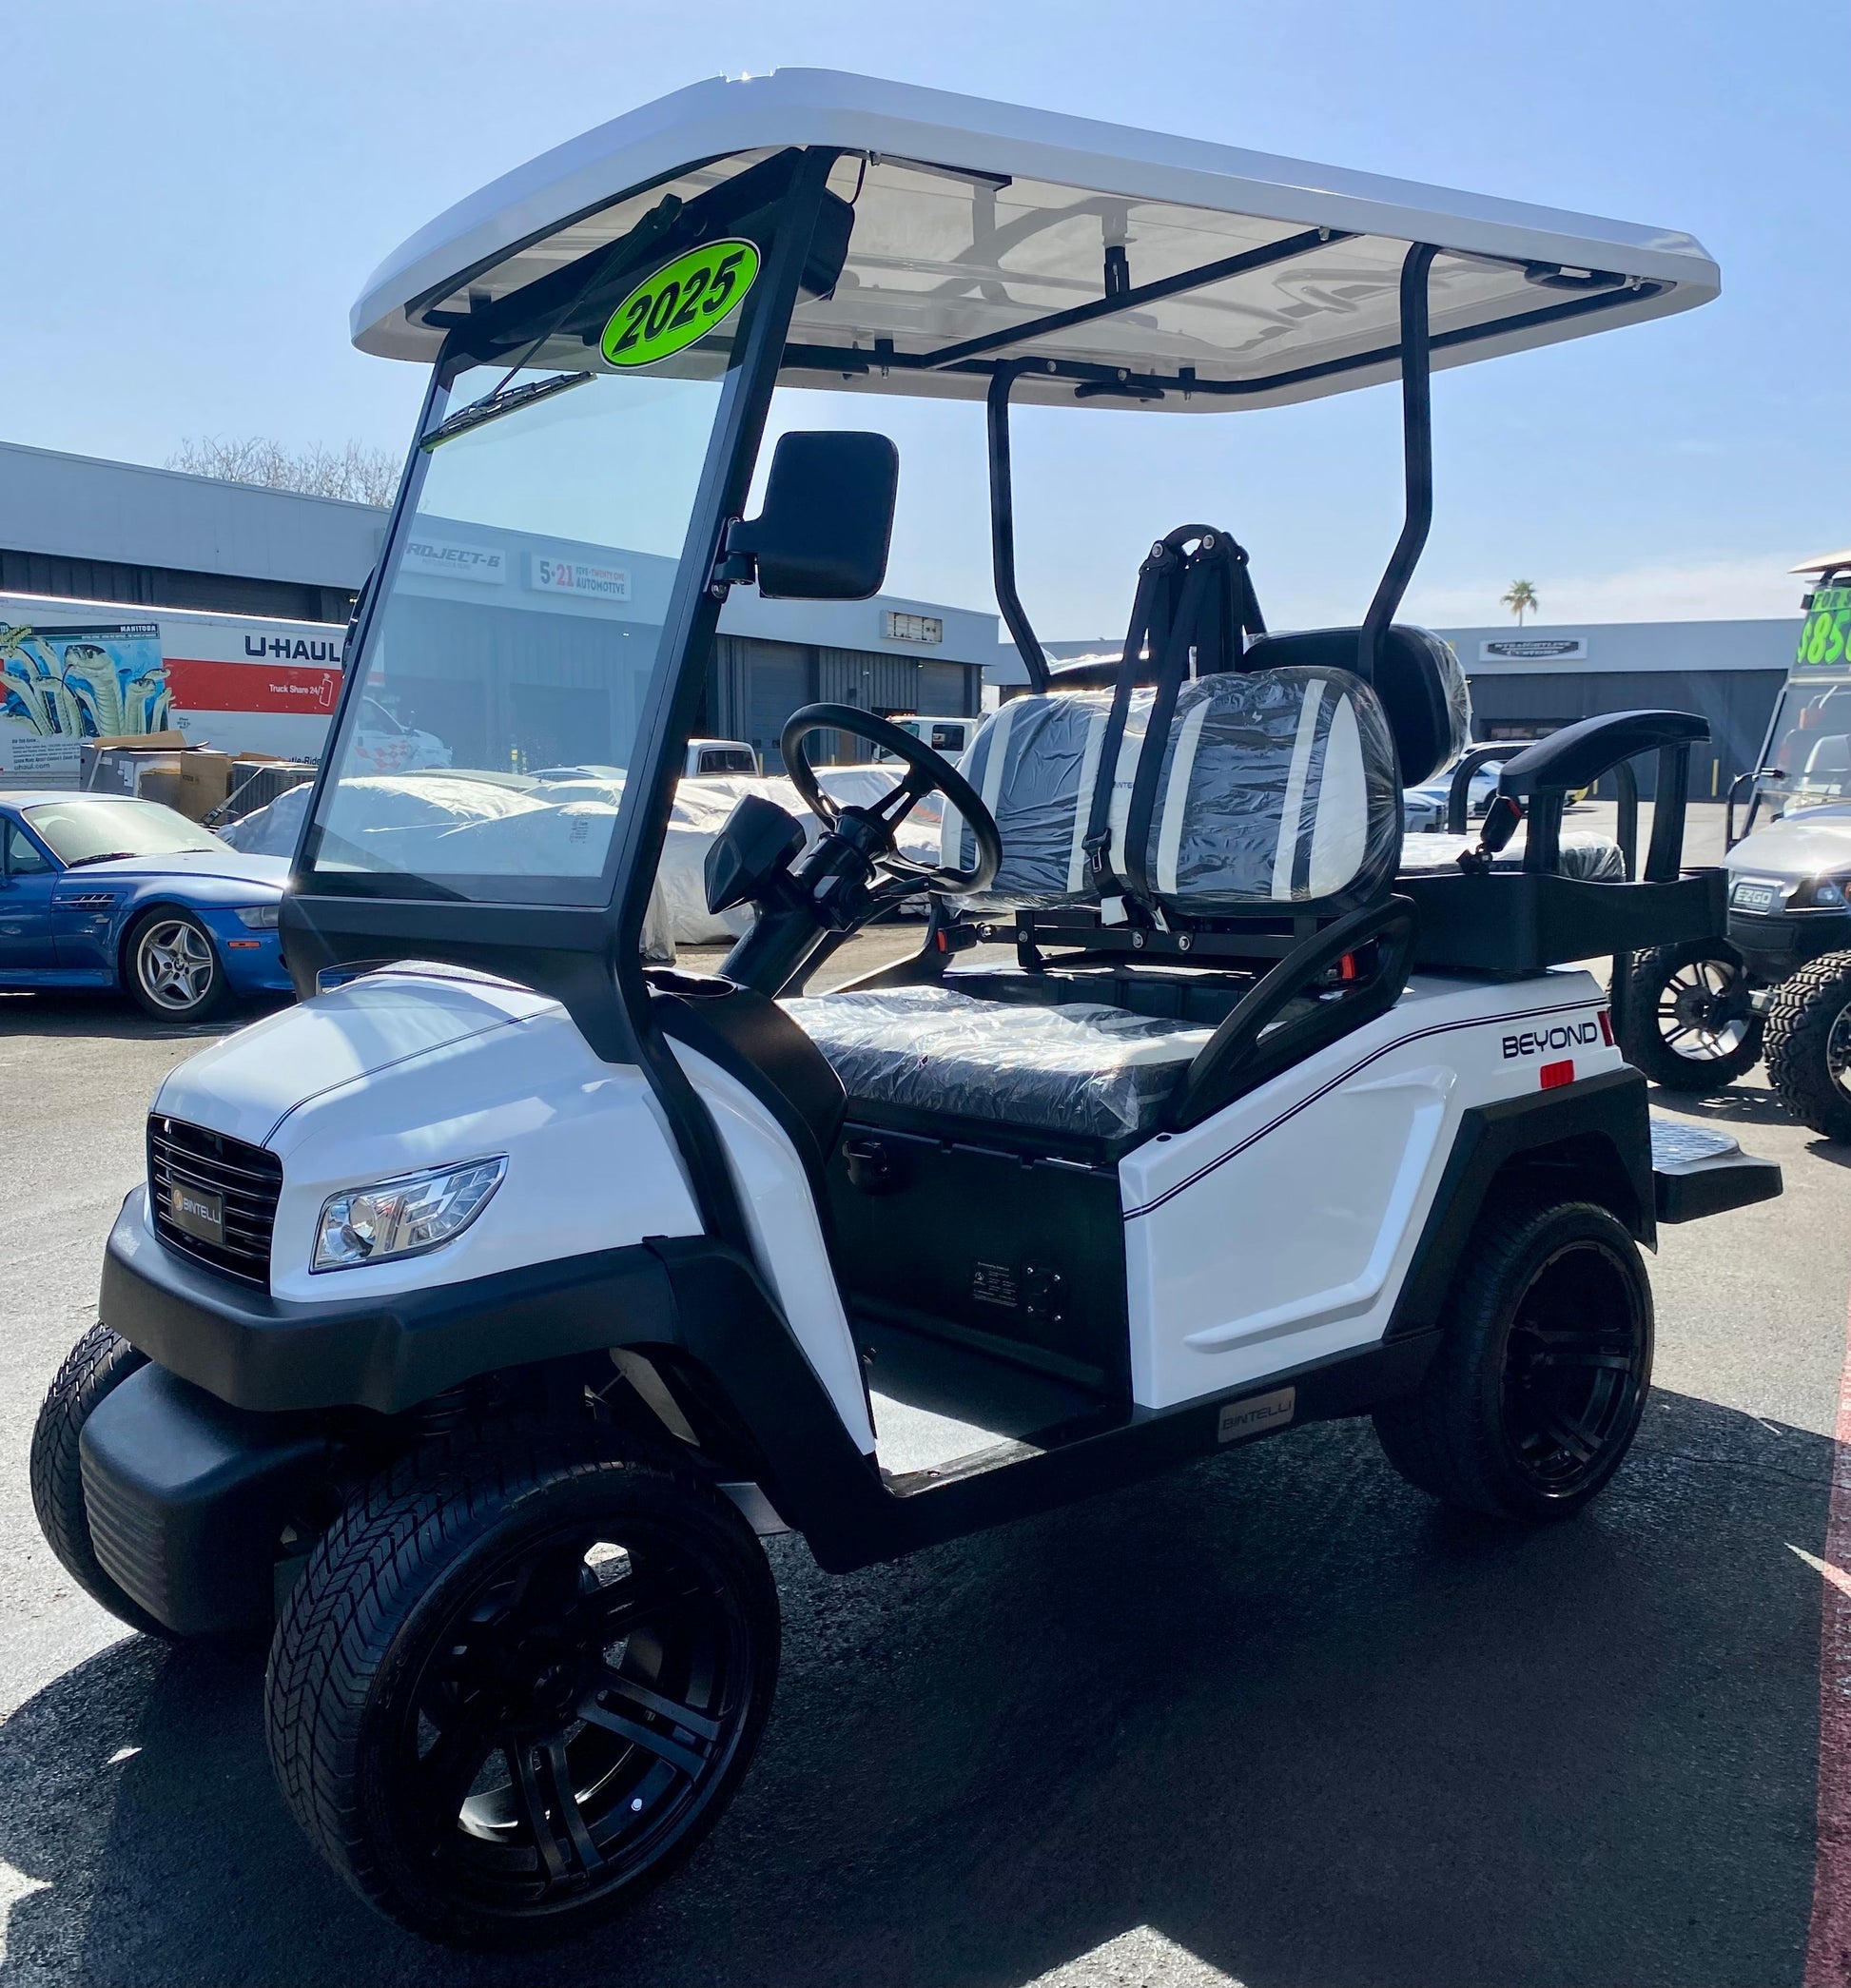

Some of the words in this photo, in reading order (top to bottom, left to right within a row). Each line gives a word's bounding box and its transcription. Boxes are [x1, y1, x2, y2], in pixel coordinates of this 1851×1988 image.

[612, 248, 747, 357] 2025
[406, 543, 500, 568] ROJECT-B
[576, 577, 625, 594] AUTOMOTIVE
[244, 635, 341, 662] U-HAUL
[269, 684, 288, 692] Truck
[289, 685, 309, 694] Share
[309, 687, 323, 695] 24/7
[1734, 888, 1772, 905] EZGO
[1503, 1022, 1598, 1059] BEYOND
[184, 1197, 222, 1224] BINTELLI
[1223, 1399, 1292, 1430] BINTELLI
